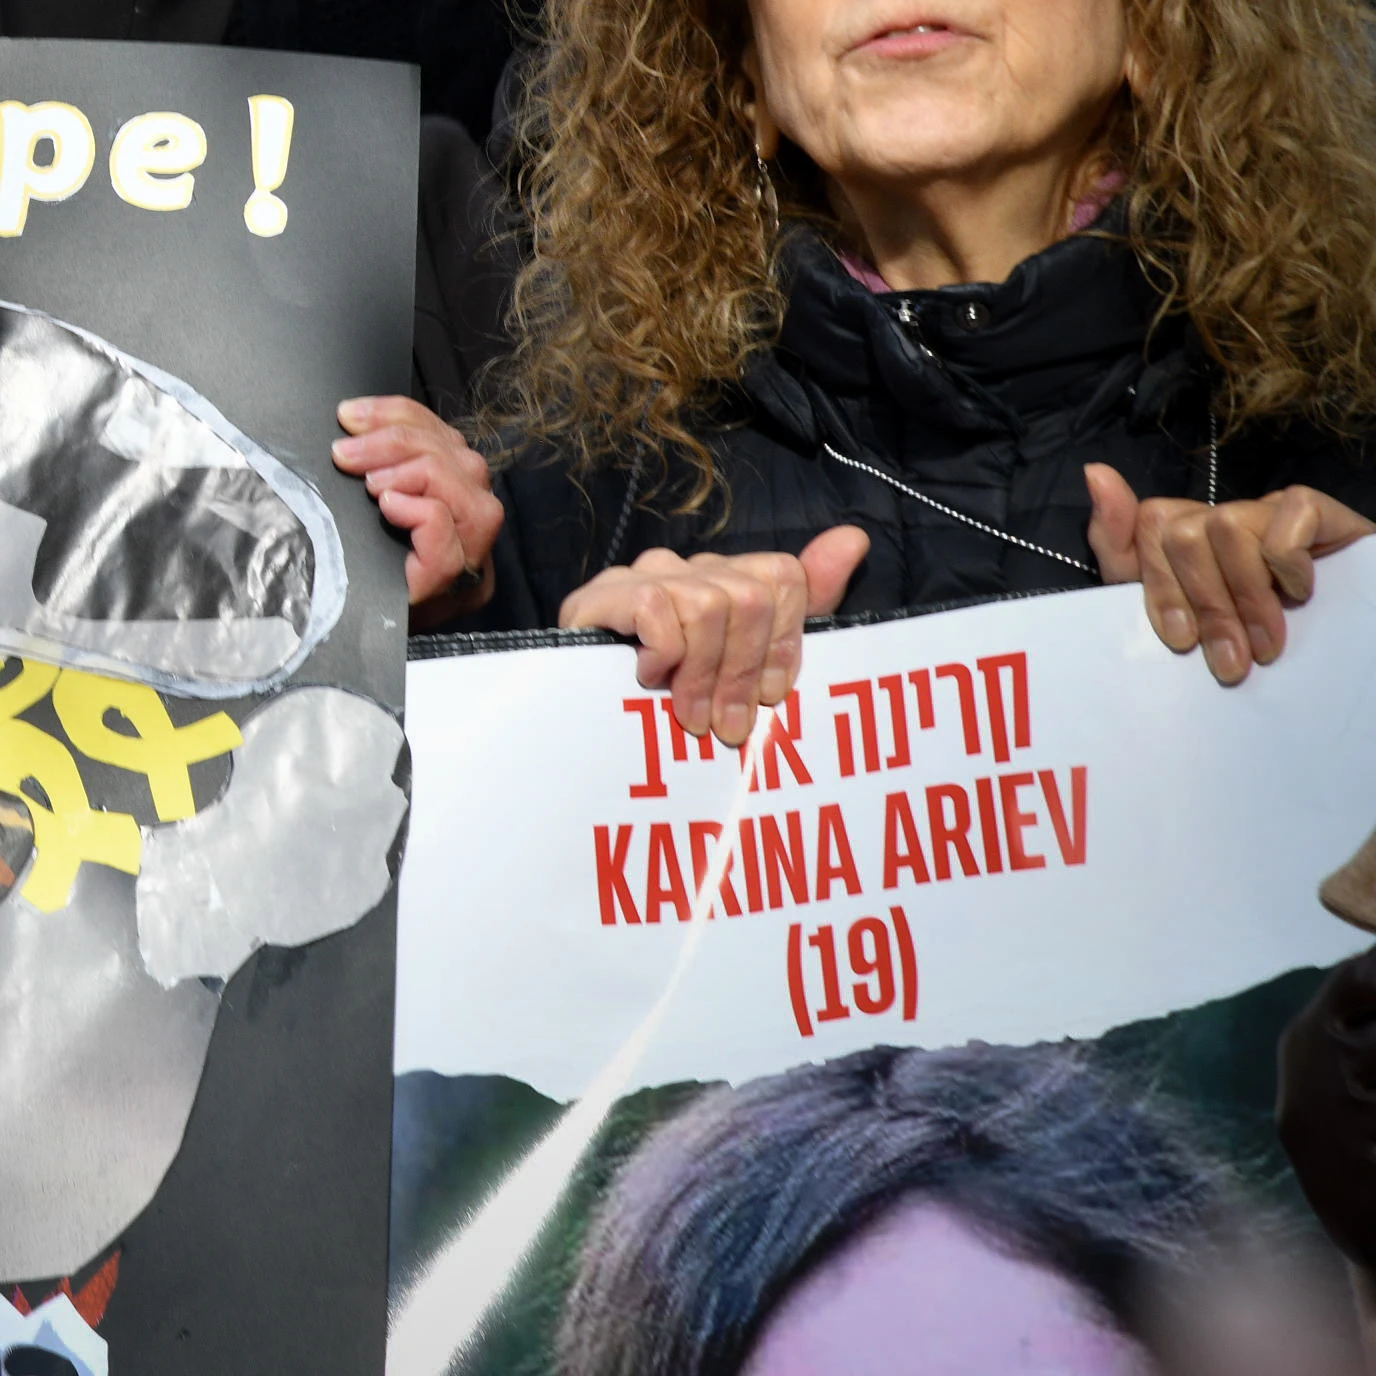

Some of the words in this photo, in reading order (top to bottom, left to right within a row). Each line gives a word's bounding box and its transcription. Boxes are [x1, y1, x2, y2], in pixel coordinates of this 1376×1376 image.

[829, 650, 1032, 776] קרינה
[592, 800, 861, 927] KARINA
[881, 765, 1088, 891] ARIEV
[785, 905, 919, 1038] (19)
